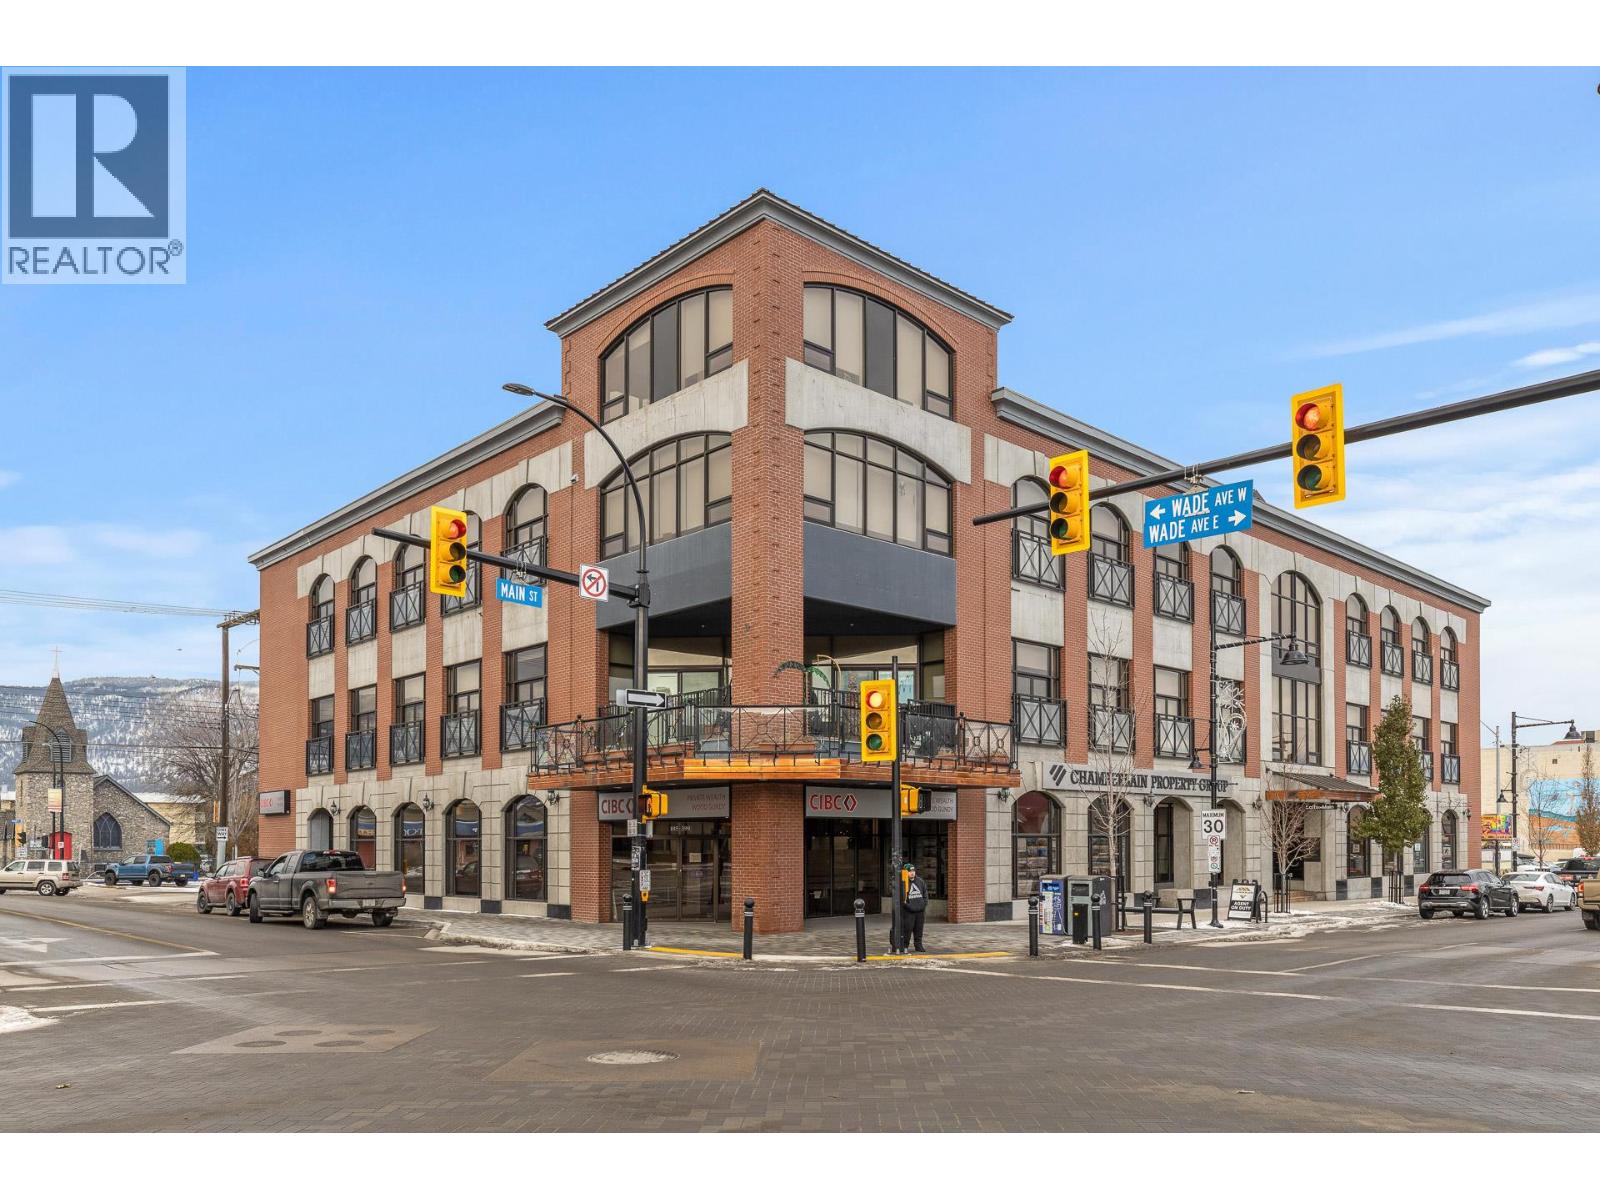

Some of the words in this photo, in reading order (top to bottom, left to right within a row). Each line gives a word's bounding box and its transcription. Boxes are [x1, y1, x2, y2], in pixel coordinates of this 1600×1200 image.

[1172, 492, 1210, 518] WADE
[1214, 489, 1234, 507] AVE
[1237, 486, 1247, 502] W
[1149, 519, 1186, 544] WADE
[1191, 516, 1209, 534] AVE
[1212, 515, 1219, 530] E
[500, 582, 526, 602] MAIN
[529, 590, 538, 603] ST
[1150, 775, 1197, 791] PROPERTY
[1198, 779, 1229, 793] GRUP
[601, 798, 625, 814] CIBC
[809, 794, 842, 810] CIBC
[1203, 819, 1224, 834] 30
